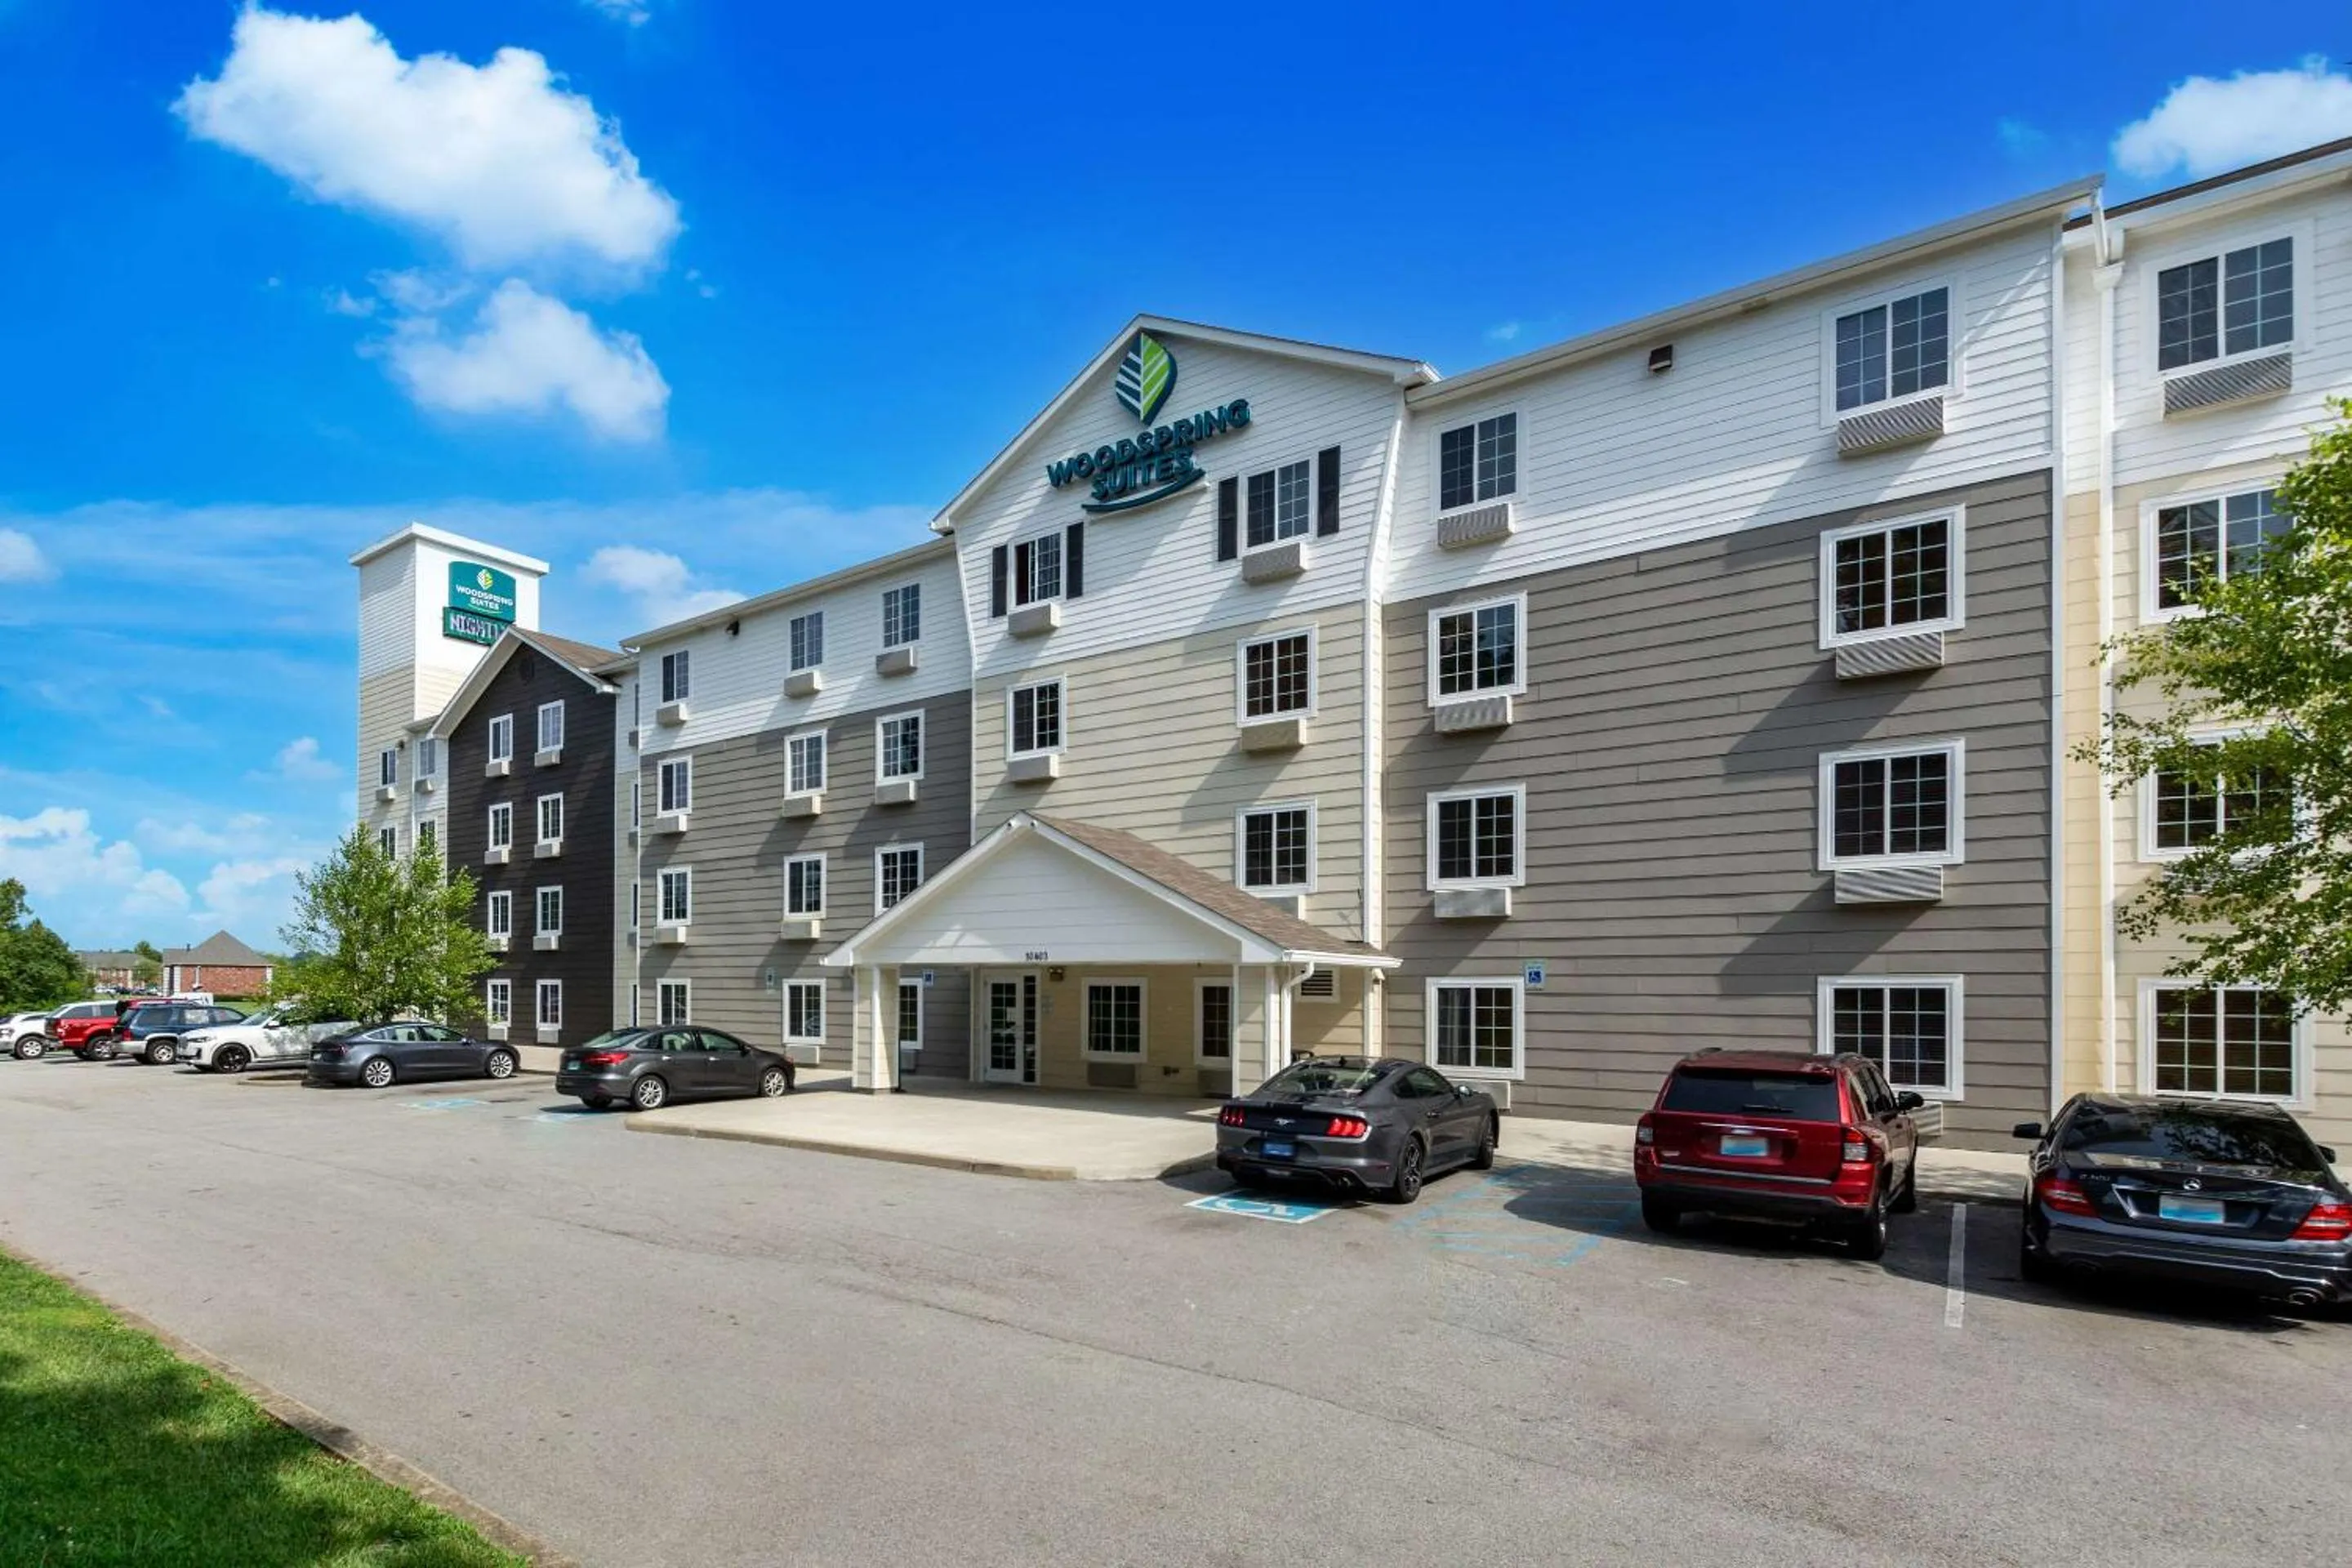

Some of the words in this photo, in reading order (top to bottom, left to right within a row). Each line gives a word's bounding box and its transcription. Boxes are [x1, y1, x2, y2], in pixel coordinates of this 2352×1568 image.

[1046, 399, 1251, 488] WOODSPRING
[1091, 448, 1195, 501] SUITES
[456, 584, 513, 606] WOODSPRING
[470, 597, 499, 610] SUITES
[450, 613, 506, 639] NIGHTL
